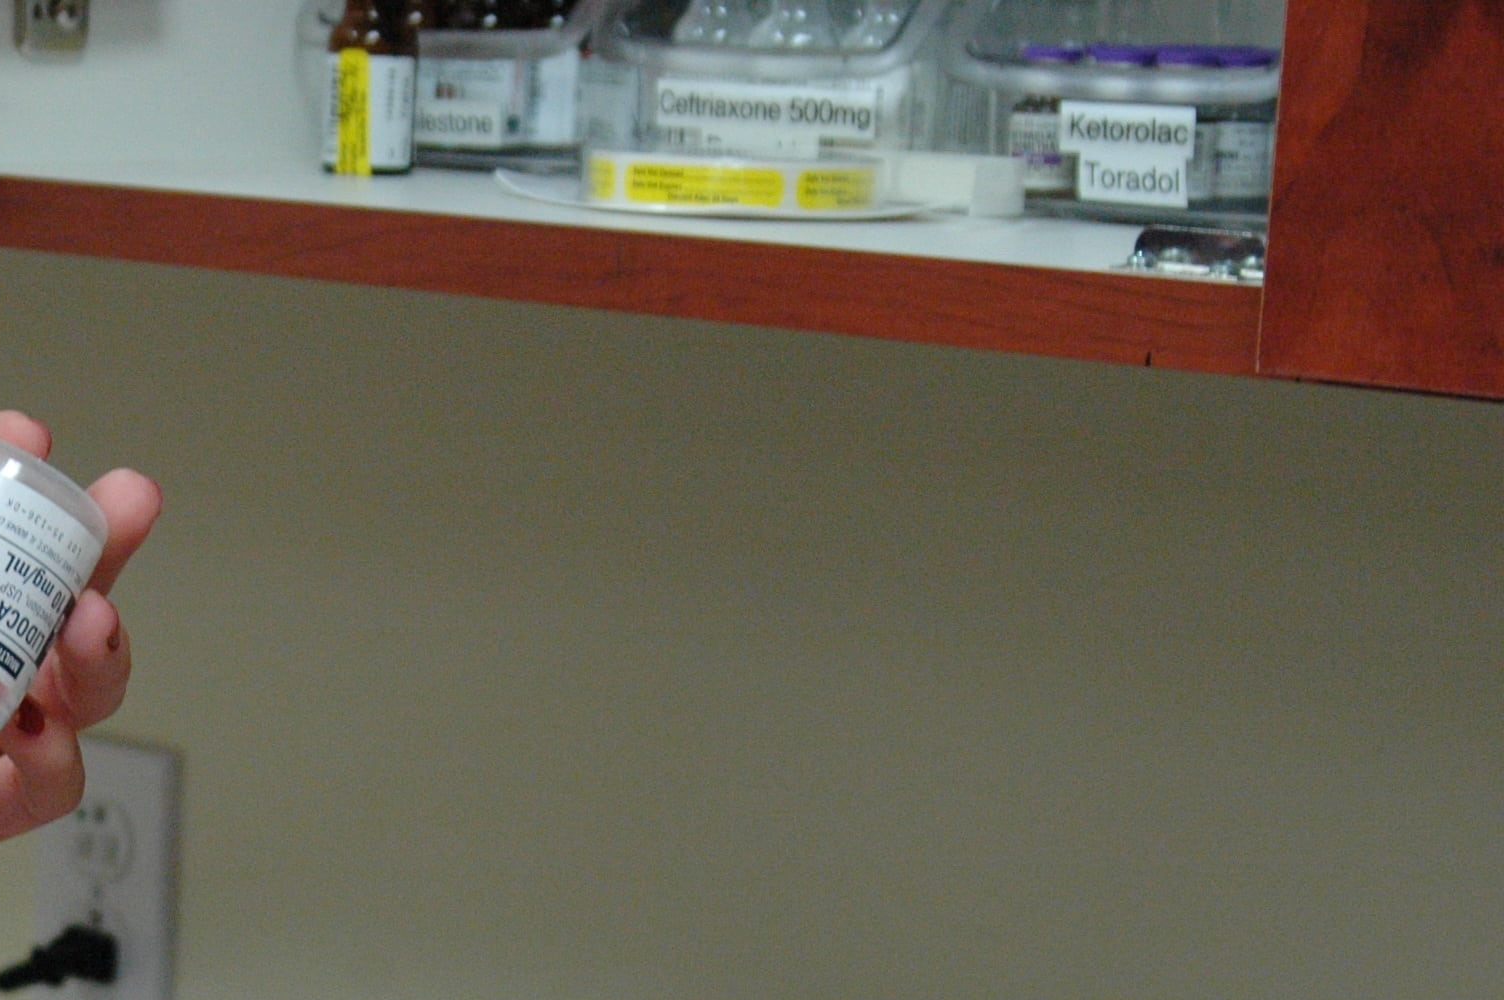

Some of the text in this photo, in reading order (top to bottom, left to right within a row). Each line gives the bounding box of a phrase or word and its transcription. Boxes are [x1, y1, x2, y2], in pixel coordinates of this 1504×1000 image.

[659, 88, 872, 130] Ceftriaxone 500mg
[1069, 112, 1189, 145] Ketorolac
[1084, 160, 1180, 193] Toradol
[4, 551, 55, 597] mg/mL
[0, 580, 23, 603] USP
[51, 591, 66, 614] 10
